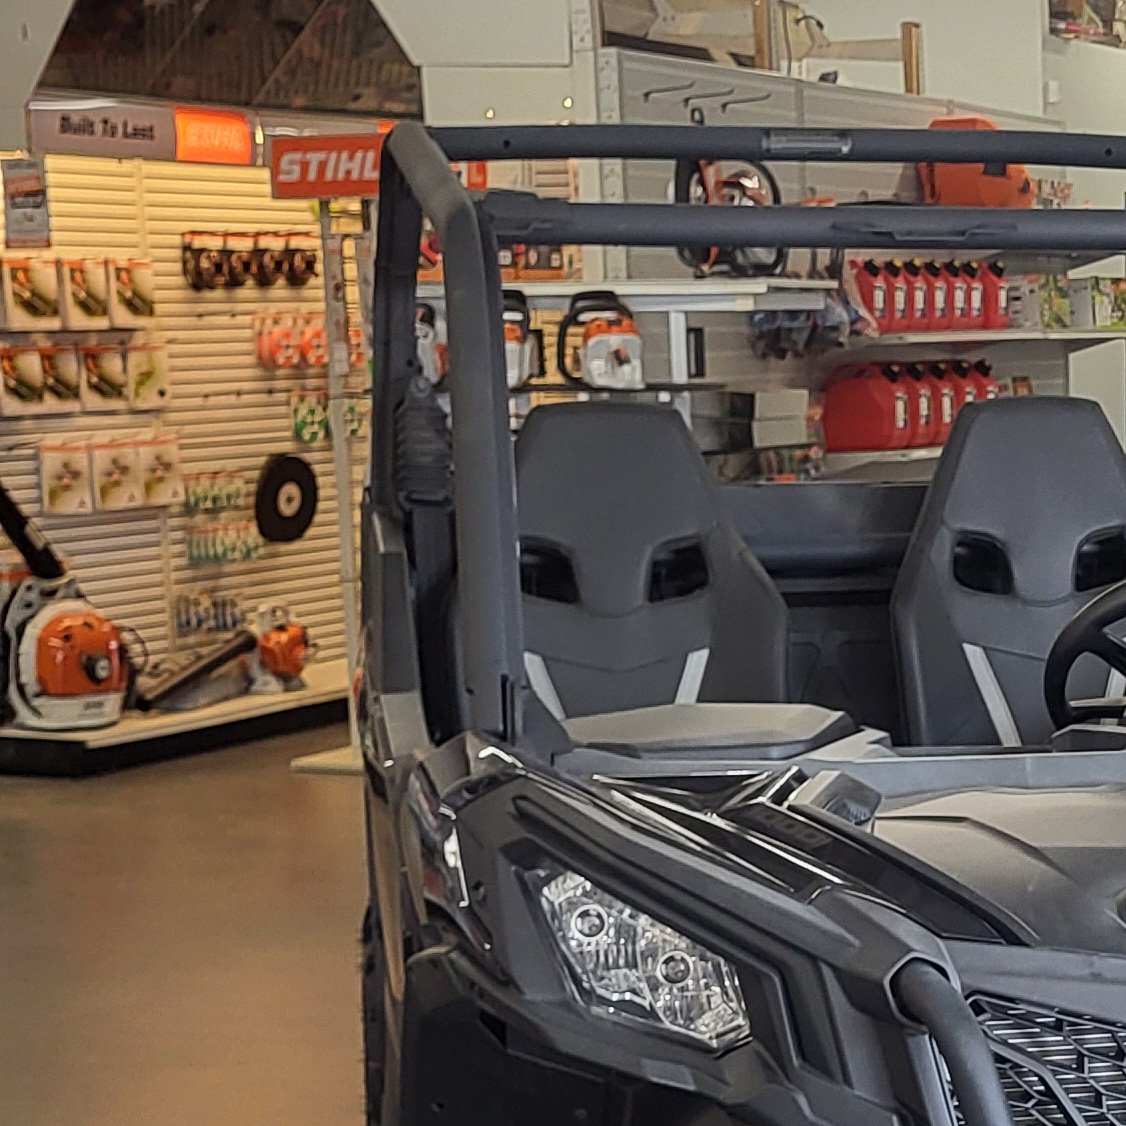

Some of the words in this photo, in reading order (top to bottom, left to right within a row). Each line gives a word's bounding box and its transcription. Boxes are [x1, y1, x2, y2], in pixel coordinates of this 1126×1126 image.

[59, 114, 95, 136] Built
[101, 117, 118, 138] To
[277, 150, 379, 183] STIHL
